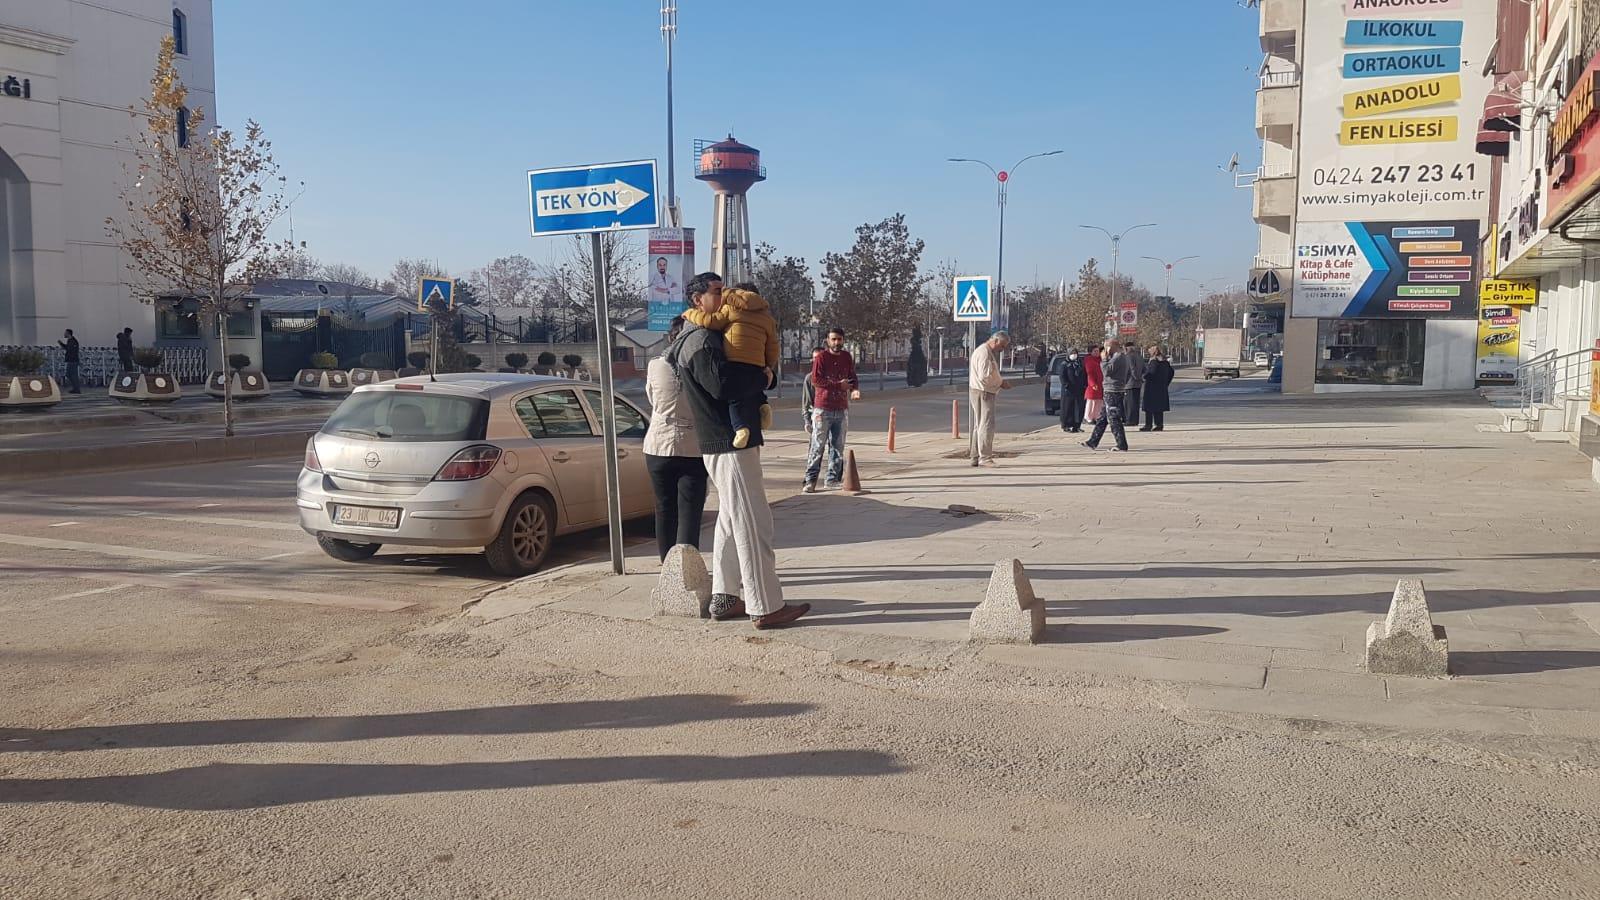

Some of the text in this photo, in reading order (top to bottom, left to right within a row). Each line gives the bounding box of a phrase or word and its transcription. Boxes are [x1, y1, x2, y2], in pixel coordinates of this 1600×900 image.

[1363, 20, 1436, 38] İLKOKUL
[1352, 53, 1446, 73] ORTAOKUL
[0, 75, 31, 98] Ğİ
[1355, 82, 1441, 110] ANADOLU
[1349, 119, 1443, 140] FEN LİSESİ
[1313, 163, 1475, 186] 0424 247 23 41
[541, 187, 617, 210] TEK YÖN
[1302, 189, 1485, 208] www.simyakoleji.com.tr
[1300, 259, 1353, 271] Kitap & Cafe
[1302, 270, 1351, 282] Kütüphane
[1485, 282, 1531, 292] FISTIK
[1493, 294, 1524, 302] Giyim
[1485, 309, 1506, 318] Şimdi
[341, 508, 353, 520] 23
[378, 510, 396, 523] 042
